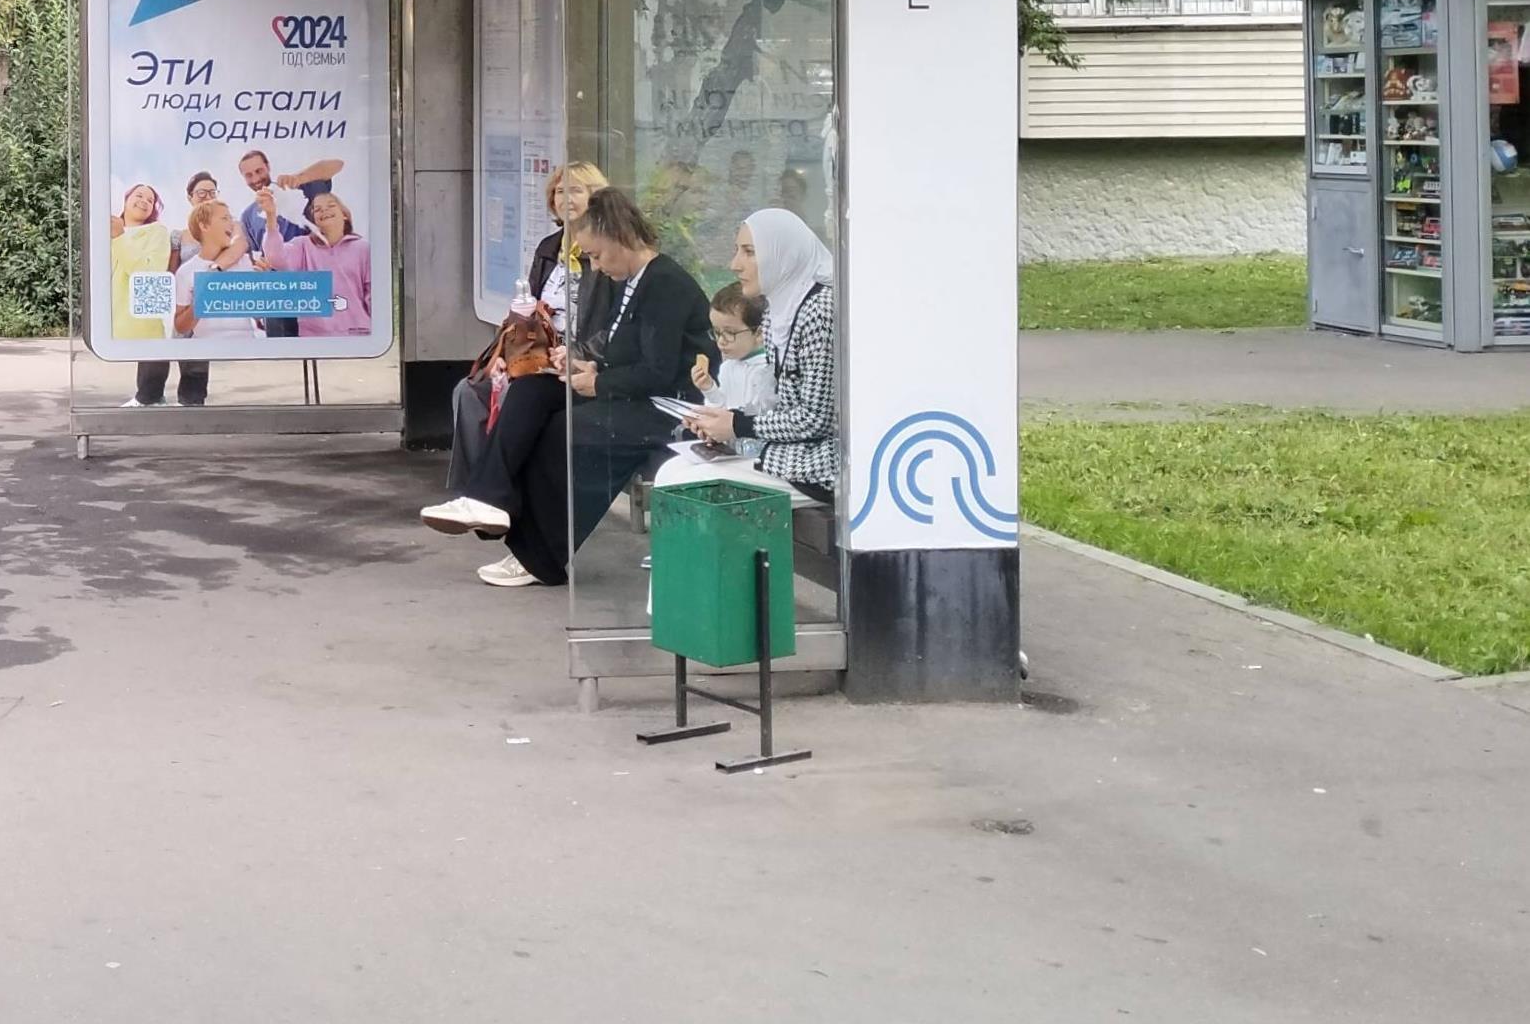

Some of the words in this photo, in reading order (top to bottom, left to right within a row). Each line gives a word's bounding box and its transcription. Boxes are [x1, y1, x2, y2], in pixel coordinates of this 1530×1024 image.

[283, 15, 348, 49] 2024
[126, 51, 214, 86] Эти
[141, 93, 221, 113] люди
[234, 90, 342, 112] стали
[184, 119, 347, 146] родными
[207, 281, 288, 291] СТАНОВИТЕСЬ
[289, 281, 298, 291] И
[300, 281, 318, 290] ВЫ
[203, 296, 321, 312] усыновите.рф
